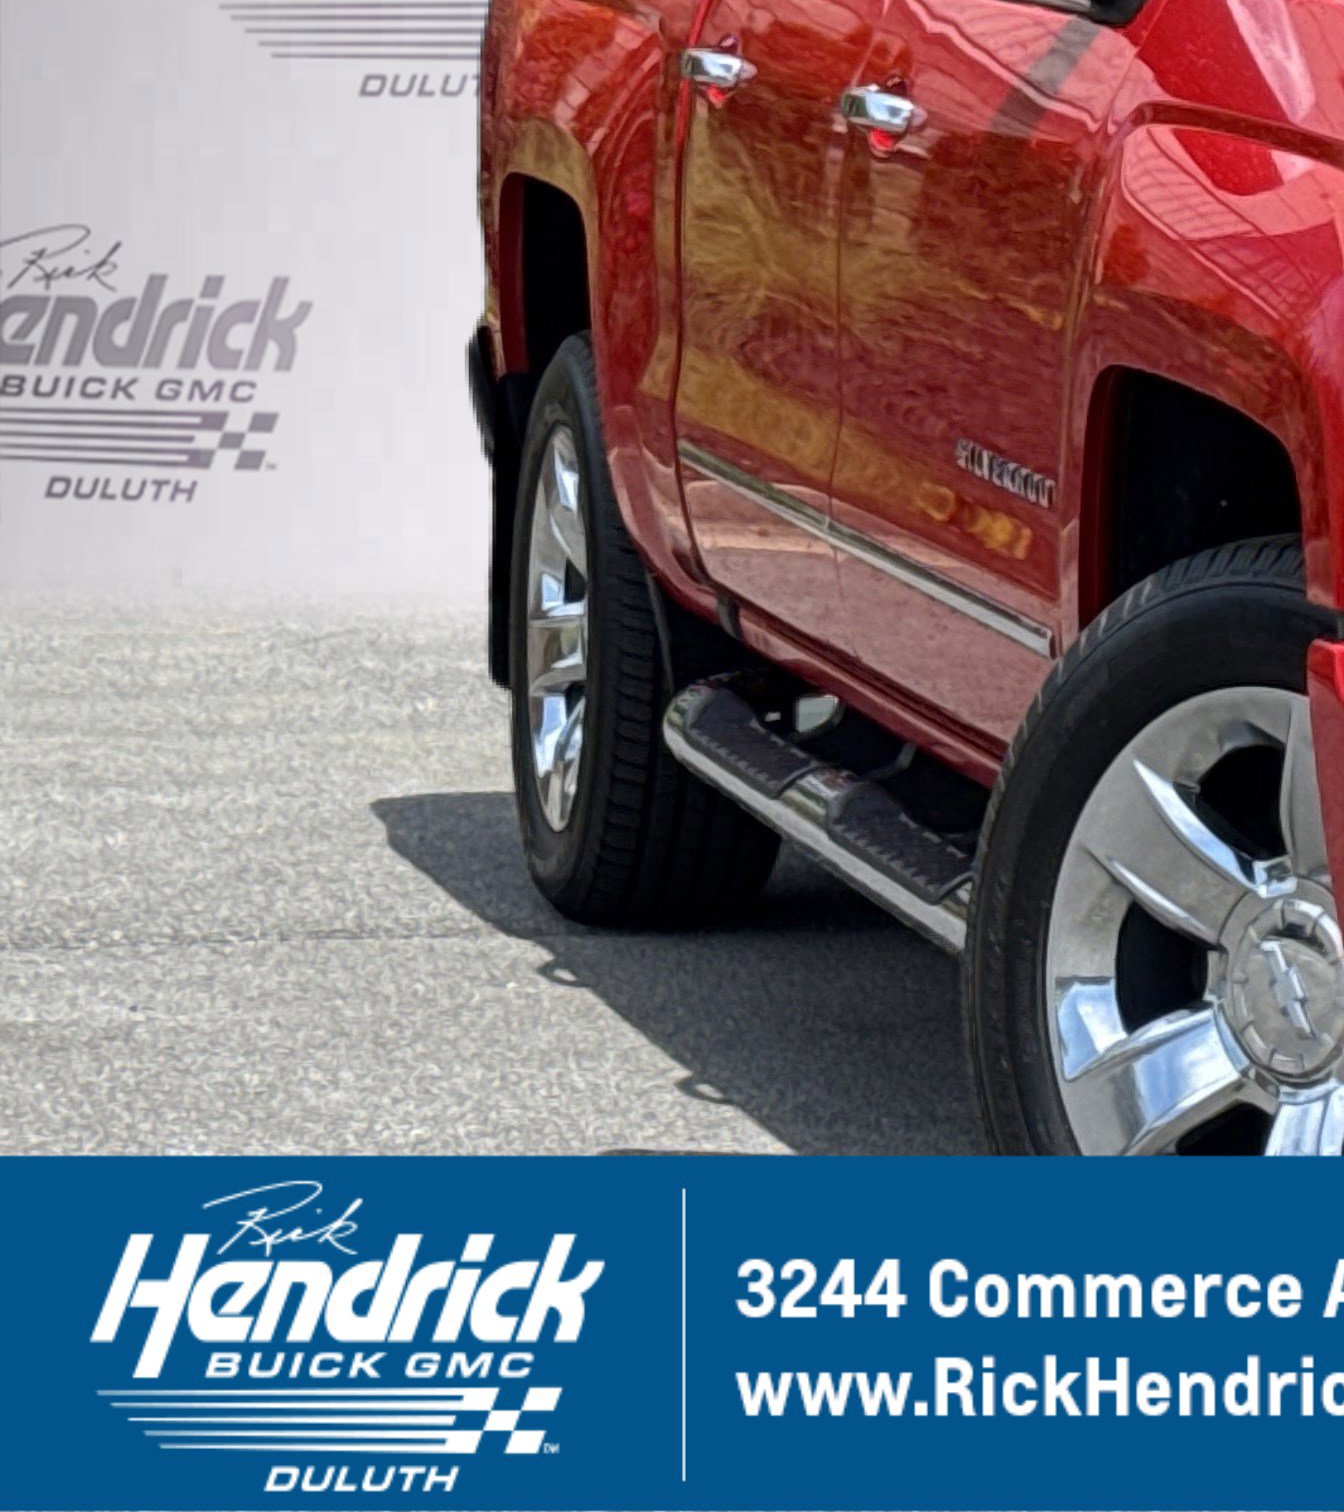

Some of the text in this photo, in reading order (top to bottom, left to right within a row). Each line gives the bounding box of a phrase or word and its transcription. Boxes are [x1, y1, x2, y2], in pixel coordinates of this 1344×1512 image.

[0, 273, 312, 372] endrick
[0, 374, 258, 404] BUICK GMC
[44, 476, 198, 503] DULUTH
